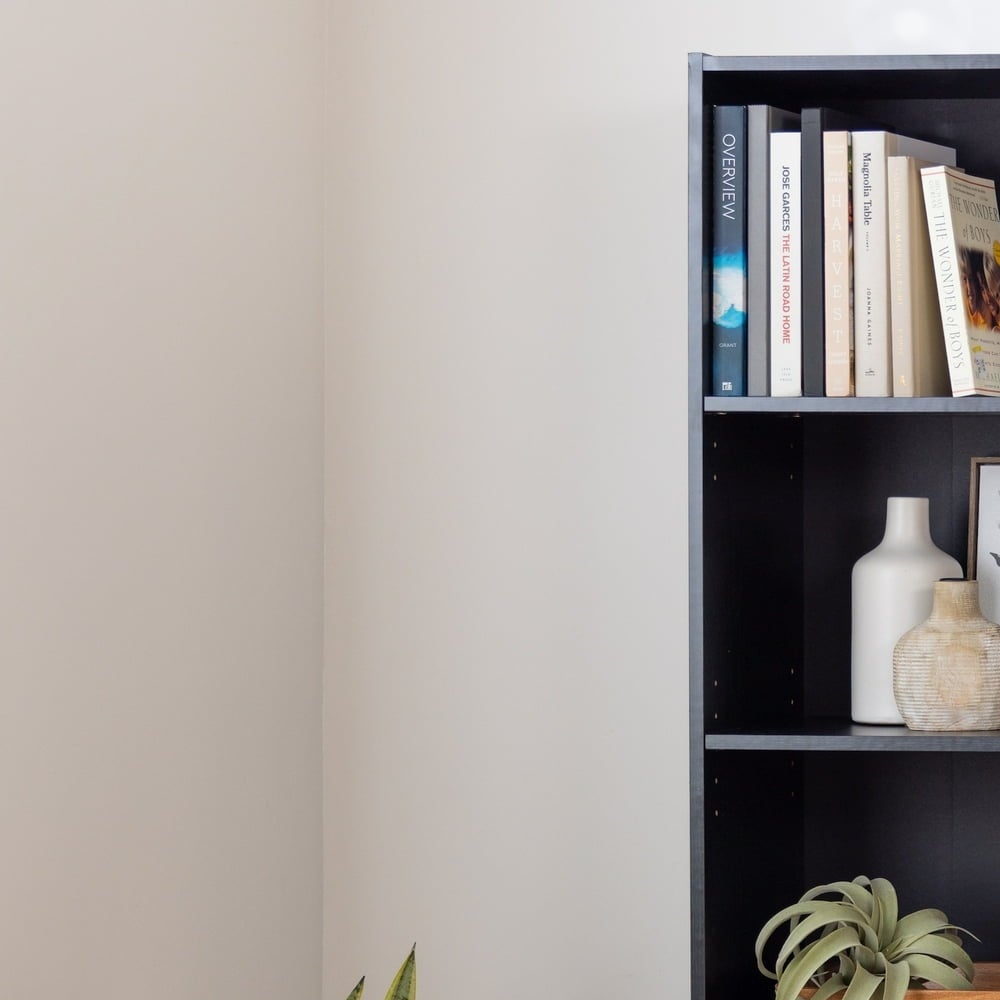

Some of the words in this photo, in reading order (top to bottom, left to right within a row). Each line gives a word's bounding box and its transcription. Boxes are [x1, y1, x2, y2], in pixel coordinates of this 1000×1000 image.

[722, 133, 736, 220] OVERVIEW
[781, 165, 790, 190] JOSE
[862, 152, 872, 197] Magnolia
[781, 192, 790, 232] GARCES
[962, 197, 1000, 224] WONDER
[932, 212, 948, 241] THE
[970, 223, 991, 244] BOYS
[782, 234, 791, 253] THE
[782, 255, 791, 283] LATIN
[831, 193, 844, 343] HARVEST
[937, 246, 958, 313] WONDER
[782, 285, 791, 313] ROAD
[782, 314, 791, 344] HOME
[952, 332, 965, 369] BOYS
